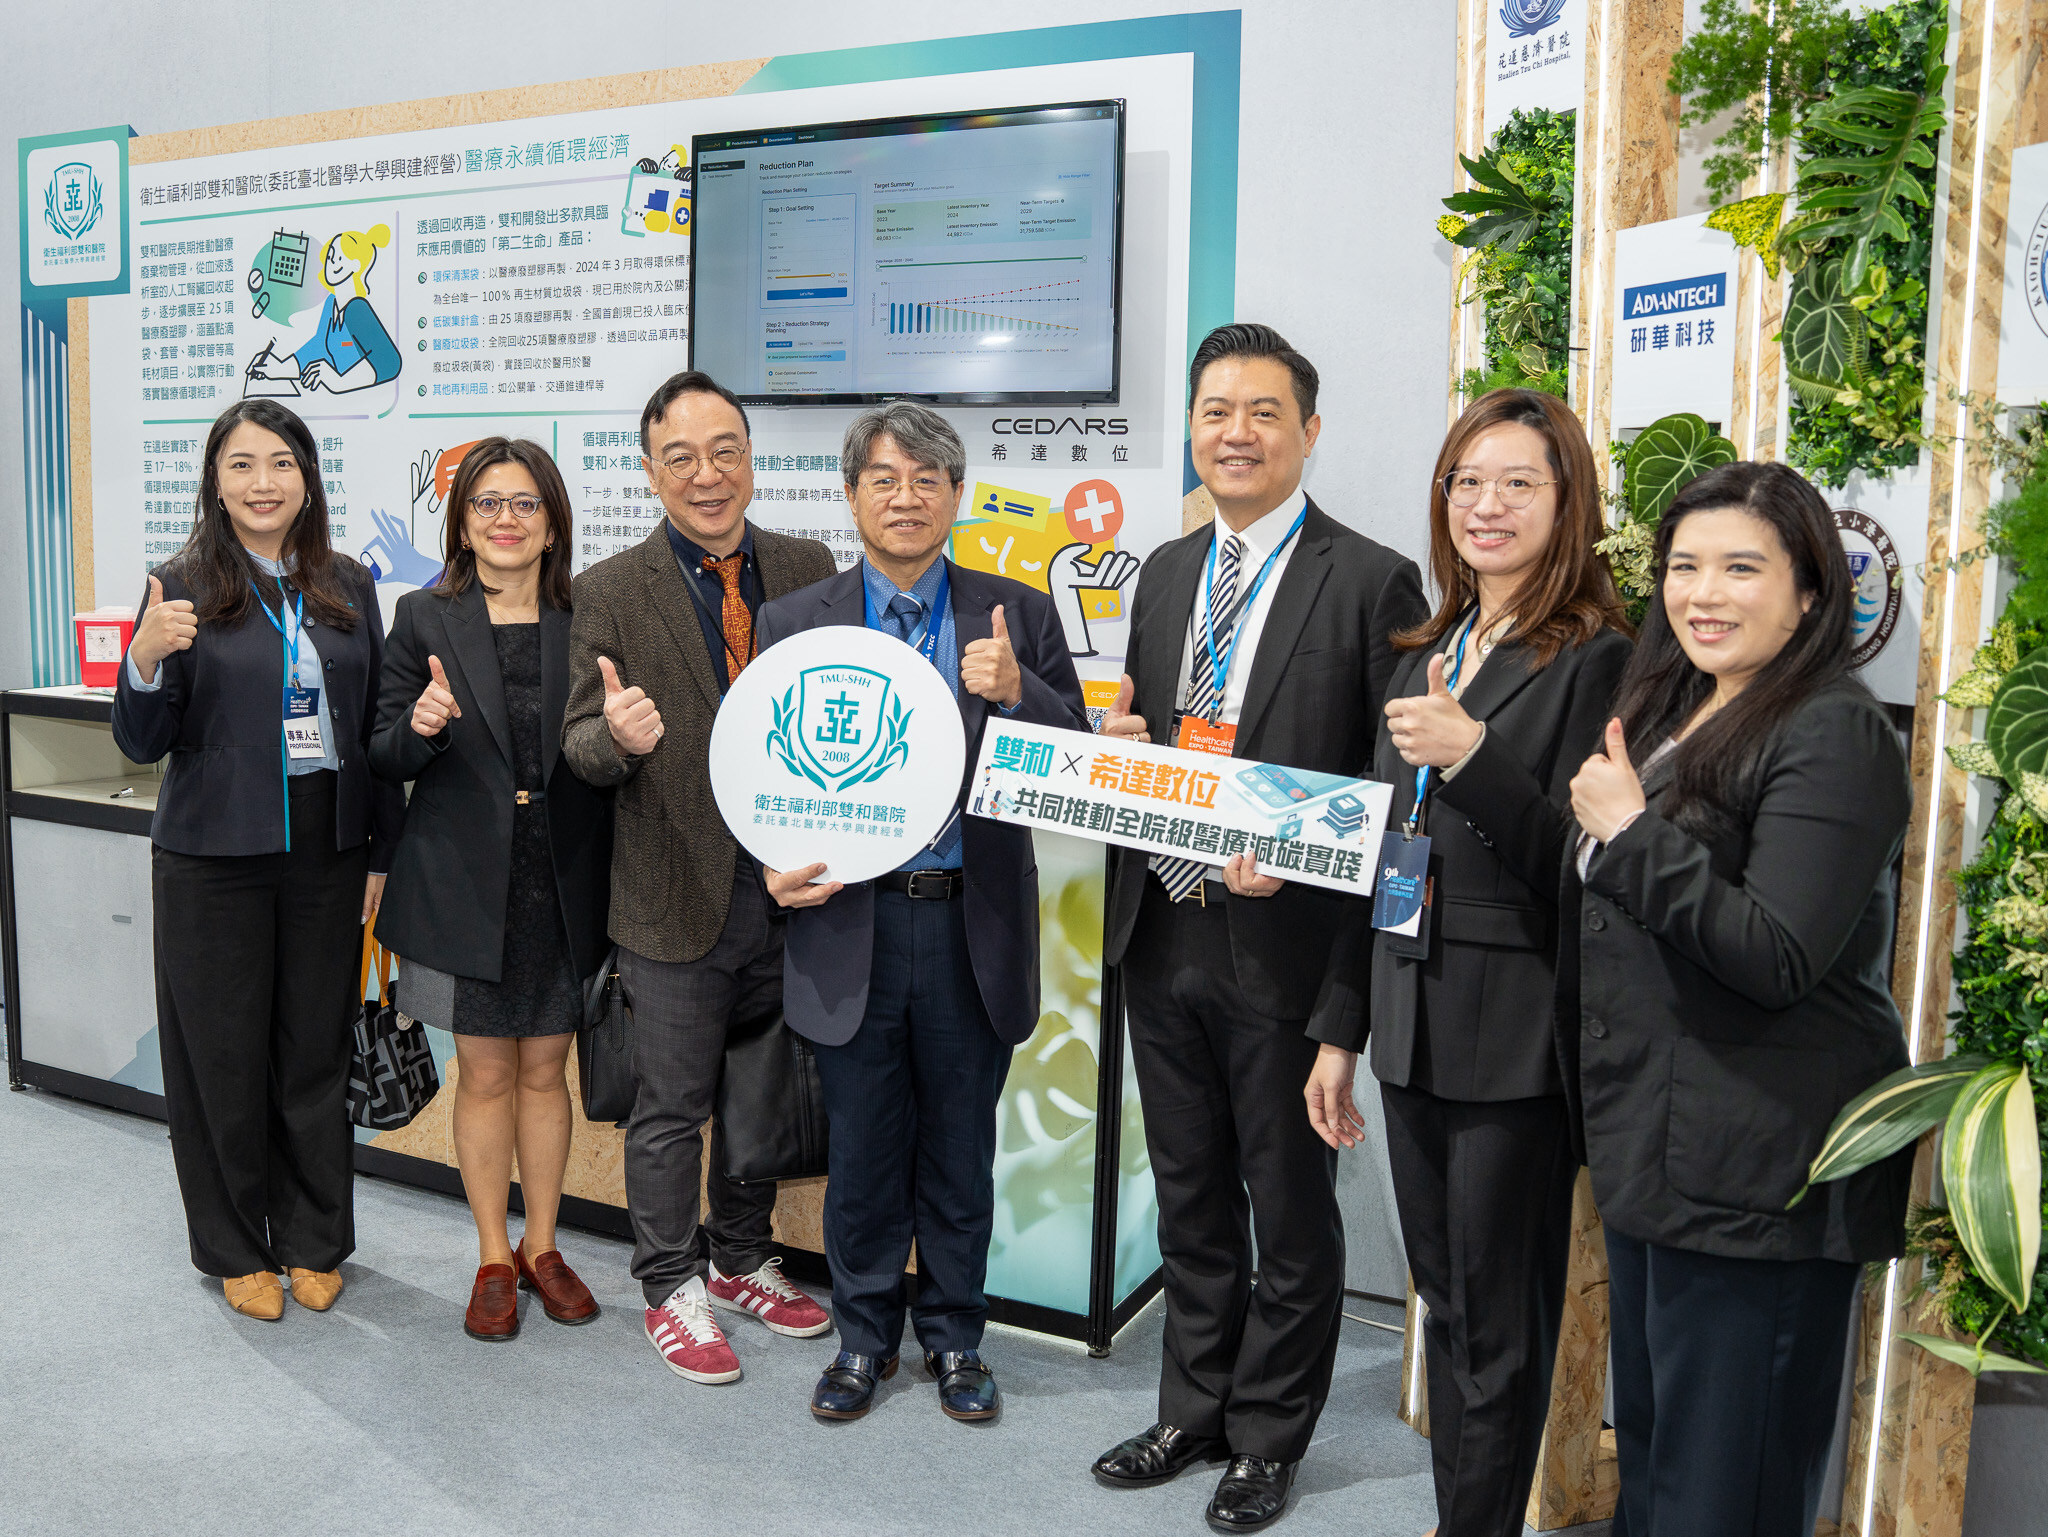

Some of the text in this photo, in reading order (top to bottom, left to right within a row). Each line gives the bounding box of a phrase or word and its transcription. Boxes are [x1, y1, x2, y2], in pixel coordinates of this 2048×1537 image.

[1498, 69, 1520, 81] Hualien
[1532, 60, 1543, 69] Chi
[465, 133, 630, 173] 醫療永續循環經濟
[759, 160, 814, 171] Reduction Plan
[416, 204, 609, 234] 透過回收再造，雙和開發出多款具臨
[140, 237, 234, 259] 雙和醫院長期推動醫療
[140, 258, 234, 279] 廢棄物管理，從血液透
[601, 260, 612, 271] 年
[614, 259, 620, 271] 3
[140, 280, 234, 299] 析室的人工腎臟回收起
[482, 290, 511, 302] 100%
[209, 302, 222, 315] 25
[224, 300, 234, 315] 項
[1631, 284, 1718, 316] ADVANTECH
[500, 313, 511, 325] 25
[141, 321, 234, 340] 醫療廢塑膠，涵蓋點滴
[1630, 318, 1715, 353] 研華科技
[141, 342, 235, 361] 袋、套管、導尿管等高
[142, 363, 235, 381] 耗材項目，以實際行動
[992, 417, 1129, 435] CEDARS
[322, 437, 344, 452] 提升
[991, 444, 1128, 462] 希達數位
[143, 460, 153, 473] 至
[322, 459, 344, 473] 隨著
[753, 455, 842, 472] 推動全範疇醫
[323, 480, 346, 495] 導入
[1879, 588, 1900, 637] HOSPITAL
[818, 673, 872, 688] TMU-SHH
[286, 729, 320, 742] 專業人士
[1189, 733, 1234, 748] Healthcare
[821, 749, 850, 763] 2008
[1188, 742, 1204, 750] EXPO
[1208, 745, 1233, 754] TAIWAN
[991, 734, 1055, 778] 雙和
[1089, 752, 1221, 809] 希達數位
[754, 793, 906, 824] 衛生福利部雙和醫院
[752, 813, 904, 838] 委託臺北醫學大學興建經營
[1012, 787, 1364, 883] 共同推動全院級醫療減碳實踐
[1384, 867, 1399, 881] 9th
